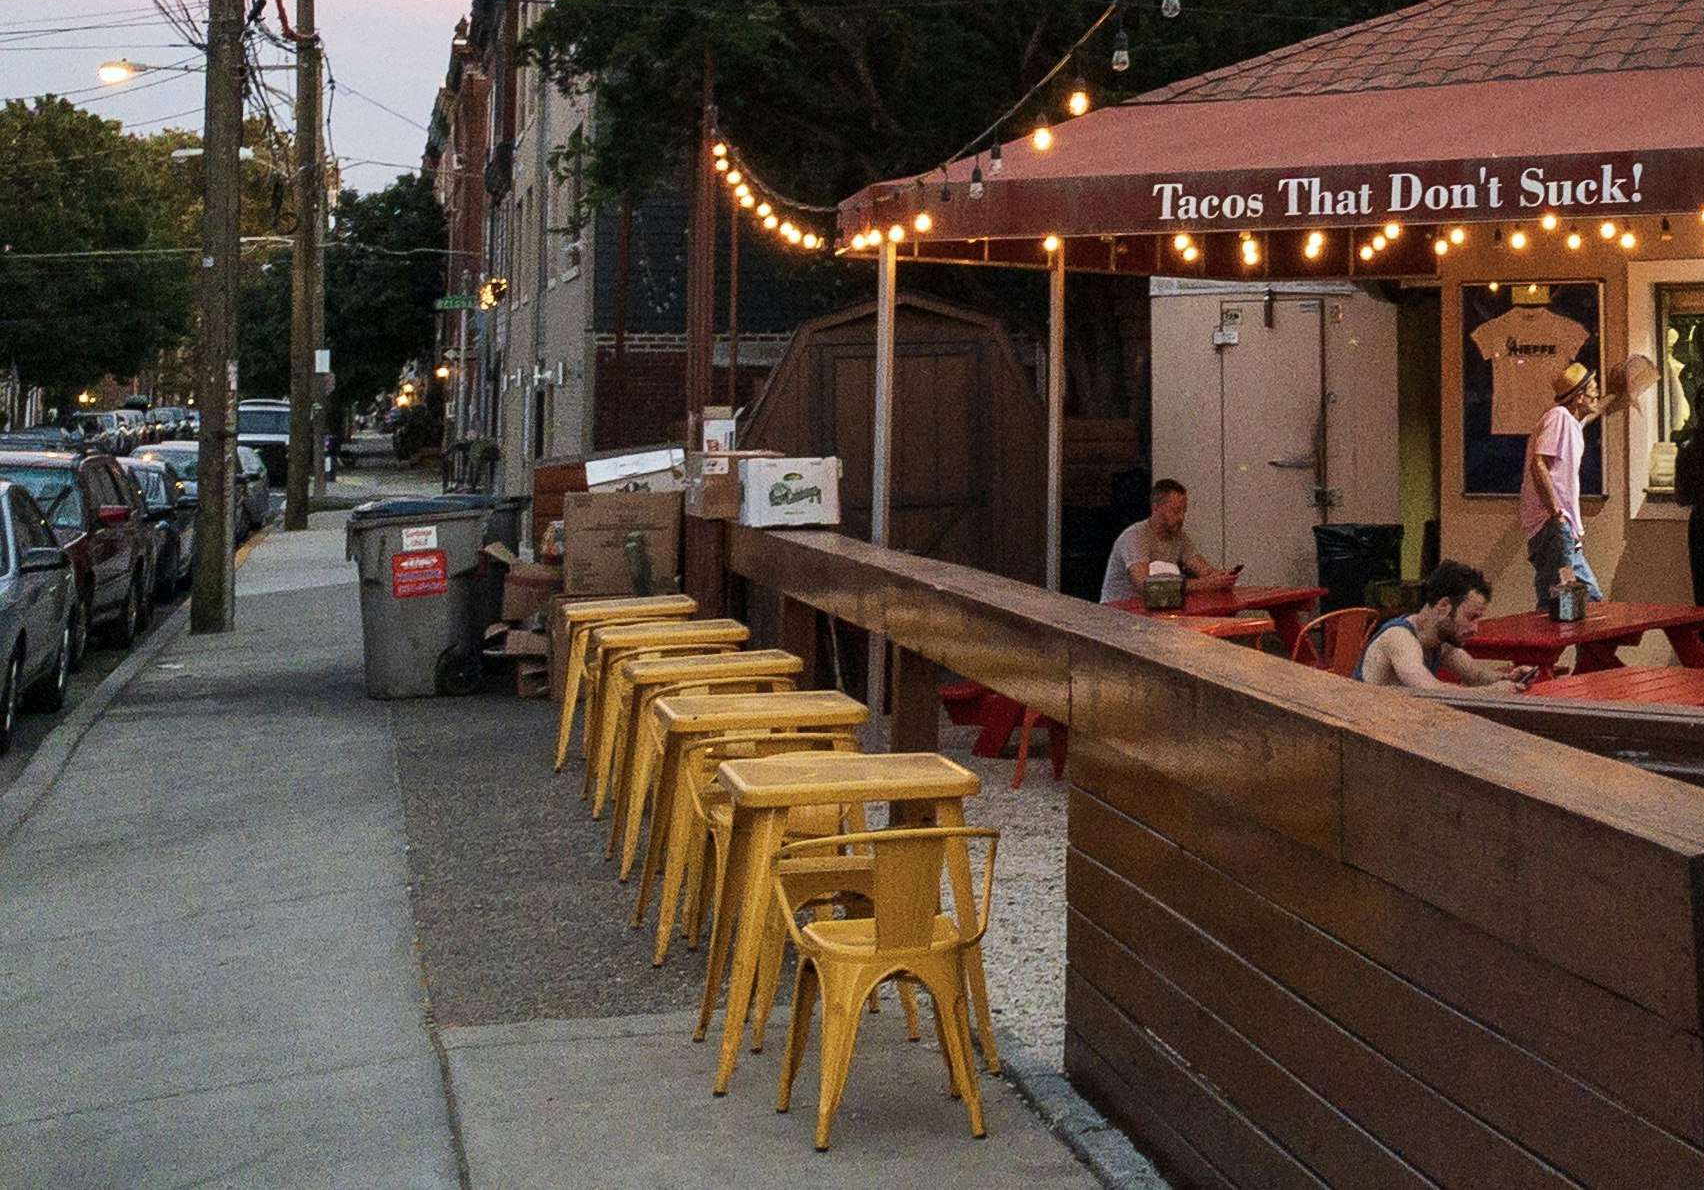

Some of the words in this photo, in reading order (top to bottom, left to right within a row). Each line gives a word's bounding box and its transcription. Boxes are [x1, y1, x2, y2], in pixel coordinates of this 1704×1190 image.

[1152, 182, 1264, 221] Tacos
[1278, 176, 1373, 217] That
[1387, 166, 1504, 212] Don't
[1519, 163, 1644, 208] Suck!
